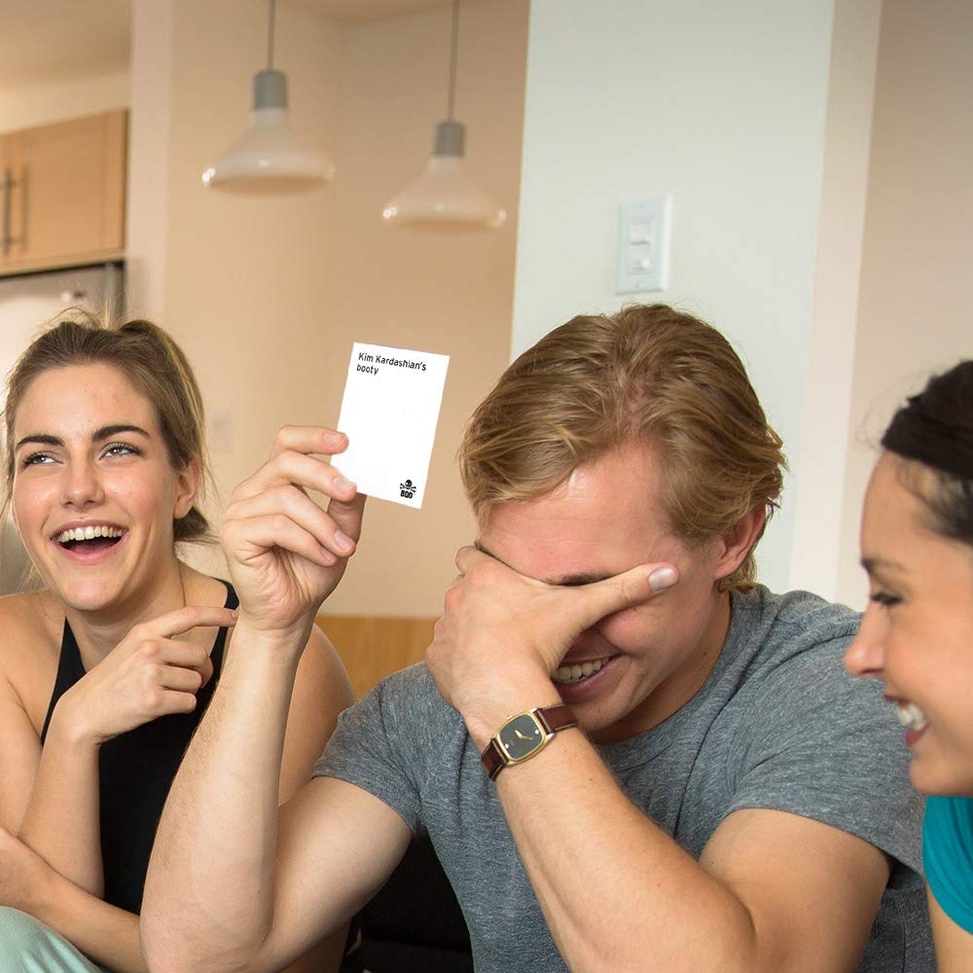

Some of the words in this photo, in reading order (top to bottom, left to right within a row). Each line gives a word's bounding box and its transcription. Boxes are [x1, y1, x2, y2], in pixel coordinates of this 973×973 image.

[356, 364, 379, 375] booty
[358, 352, 374, 362] Kim
[375, 355, 427, 372] Kardashian's
